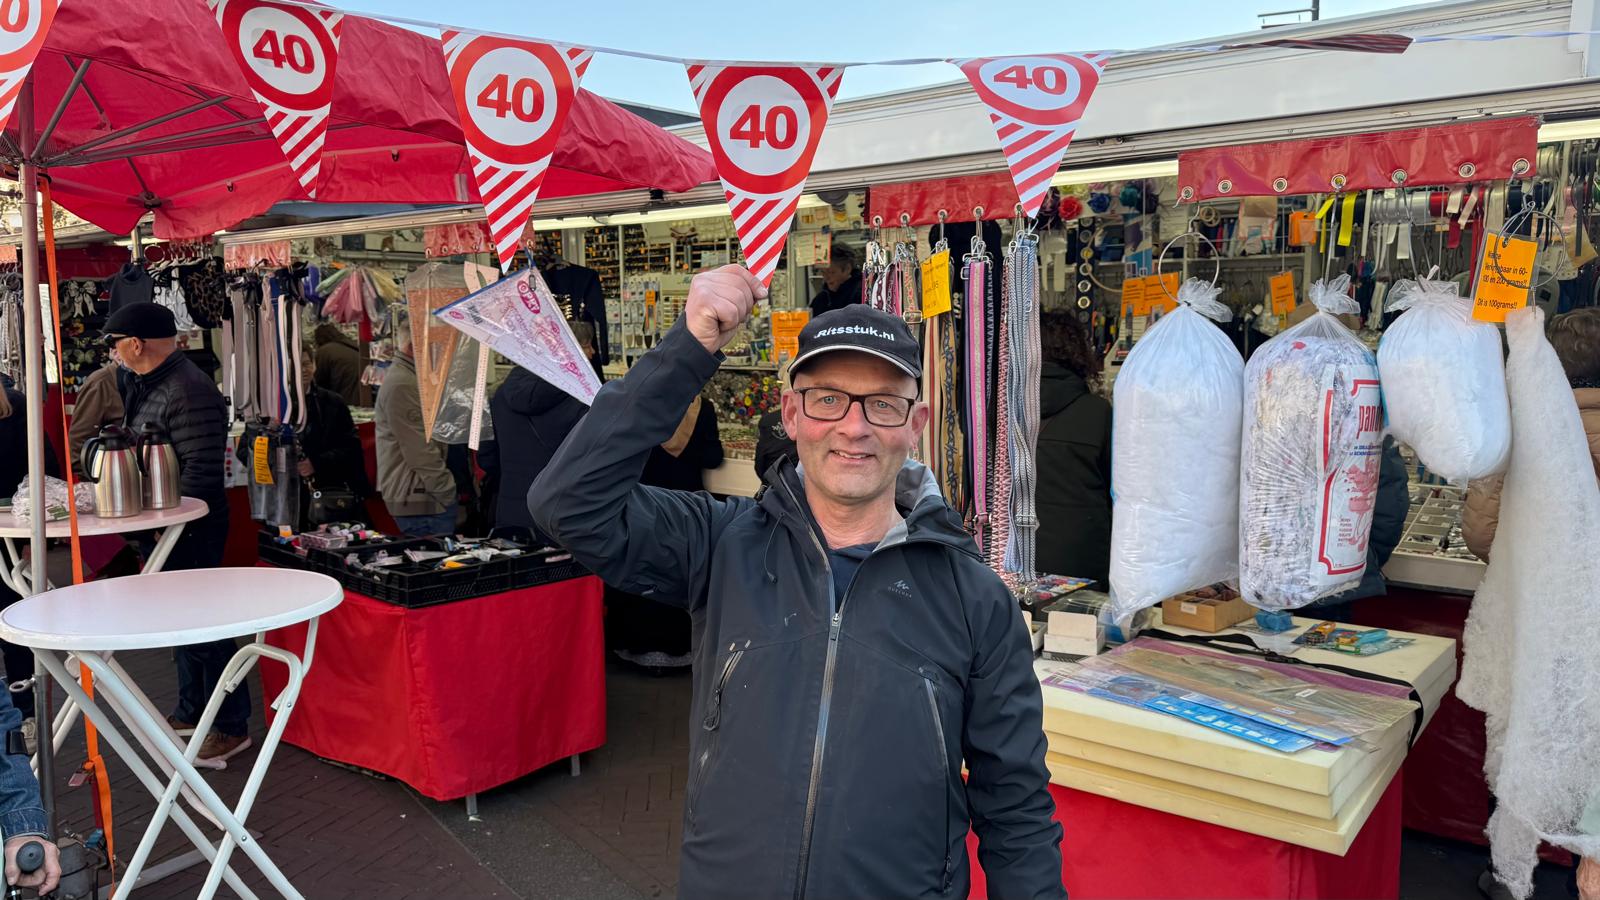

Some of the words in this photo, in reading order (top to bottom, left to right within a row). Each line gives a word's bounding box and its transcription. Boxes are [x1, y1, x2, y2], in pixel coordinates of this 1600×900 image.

[0, 0, 29, 32] 0
[253, 29, 315, 74] 40
[478, 74, 544, 123] 40
[996, 67, 1066, 95] 40
[730, 105, 798, 150] 40
